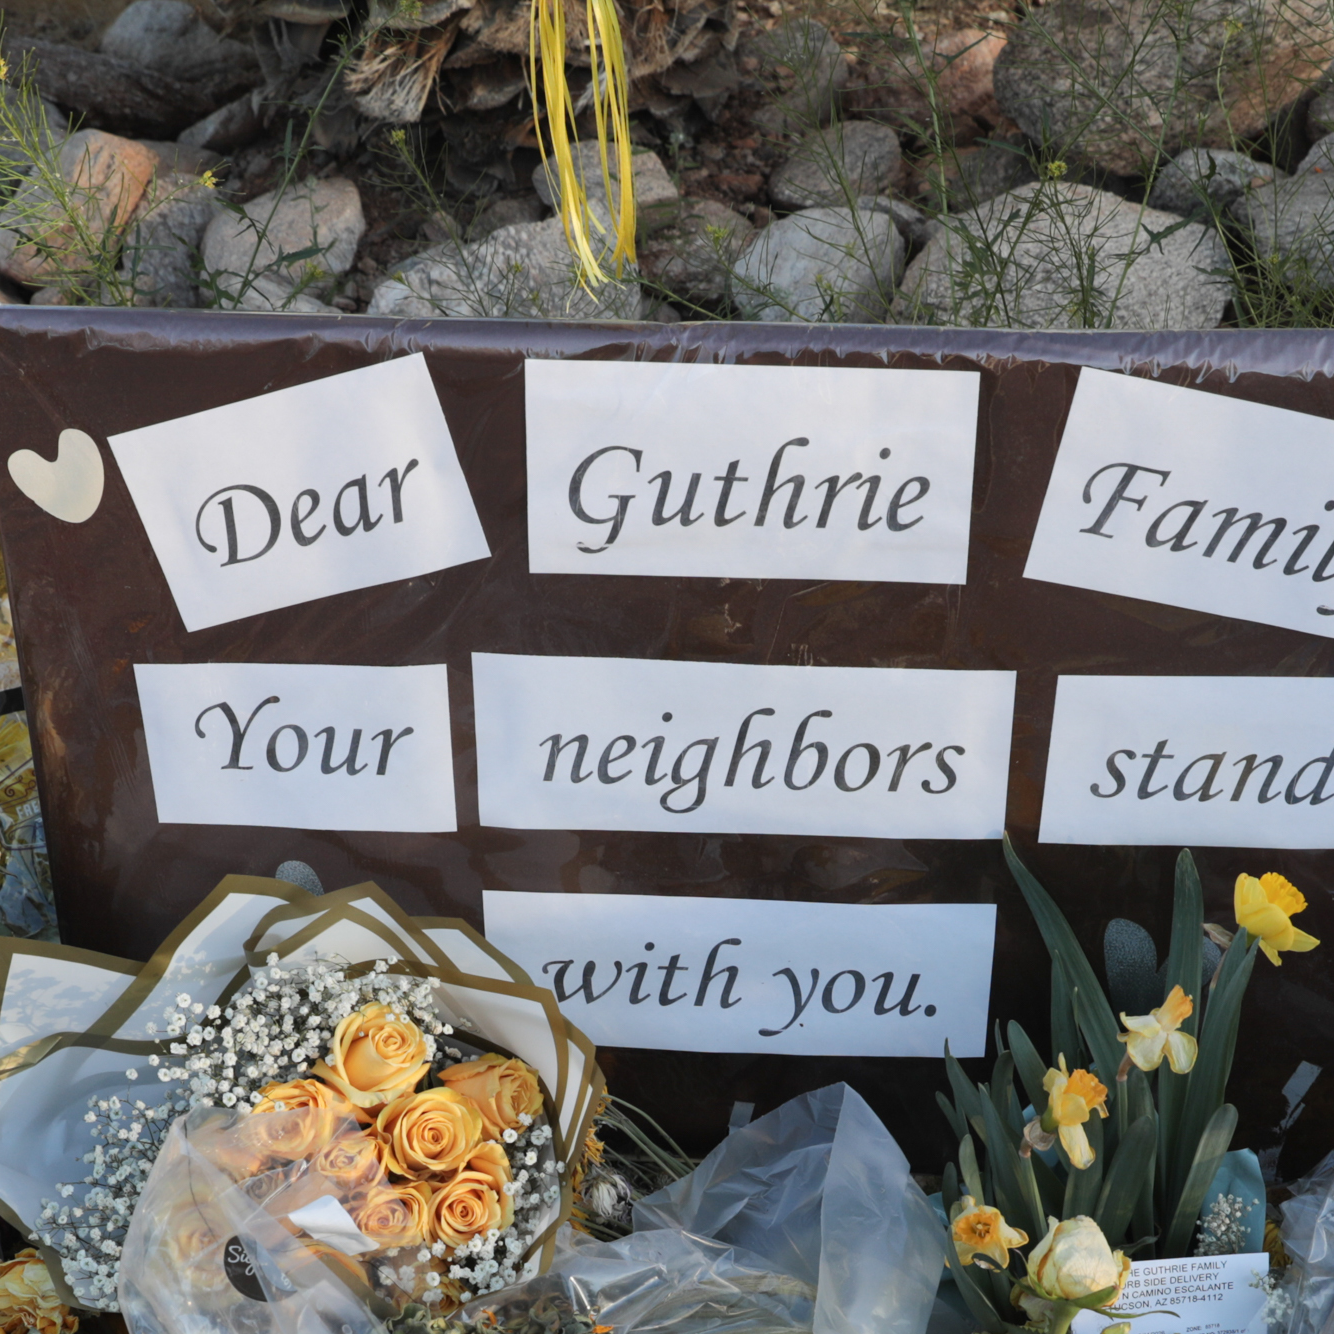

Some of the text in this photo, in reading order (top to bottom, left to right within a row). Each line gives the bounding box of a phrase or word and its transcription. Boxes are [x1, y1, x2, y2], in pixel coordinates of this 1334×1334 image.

[195, 457, 420, 568] Dear
[569, 438, 929, 553] Guthrie
[196, 696, 413, 775] Your
[540, 708, 964, 813] neighbors
[542, 938, 936, 1036] with you.
[1143, 1263, 1189, 1276] GUTHRIE
[1191, 1260, 1228, 1272] FAMILY
[1144, 1276, 1167, 1288] SIDE
[1169, 1272, 1220, 1285] DELIVERY
[1132, 1287, 1172, 1300] CAMINO
[1174, 1281, 1235, 1295] ESCALANTE
[1155, 1298, 1168, 1308] AZ
[1170, 1293, 1224, 1305] 85718-4112
